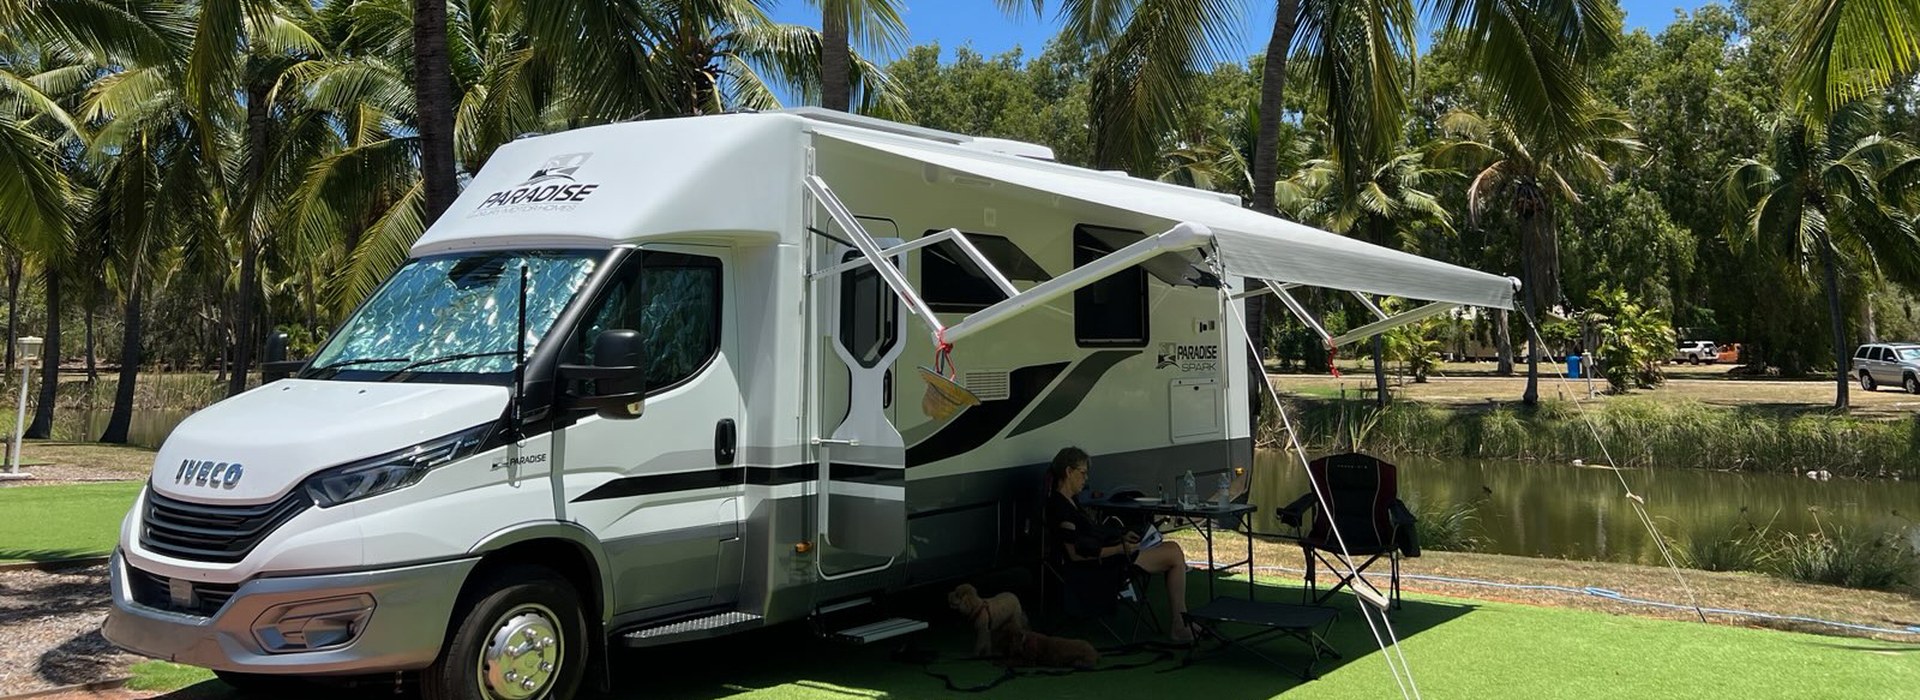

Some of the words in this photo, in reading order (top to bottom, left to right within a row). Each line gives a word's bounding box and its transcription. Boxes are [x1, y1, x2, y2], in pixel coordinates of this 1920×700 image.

[477, 184, 599, 209] PARADISE
[1177, 346, 1217, 359] PARADISE
[1181, 363, 1216, 372] SPARK
[509, 454, 546, 466] PARADISE
[175, 459, 243, 486] IVECO
